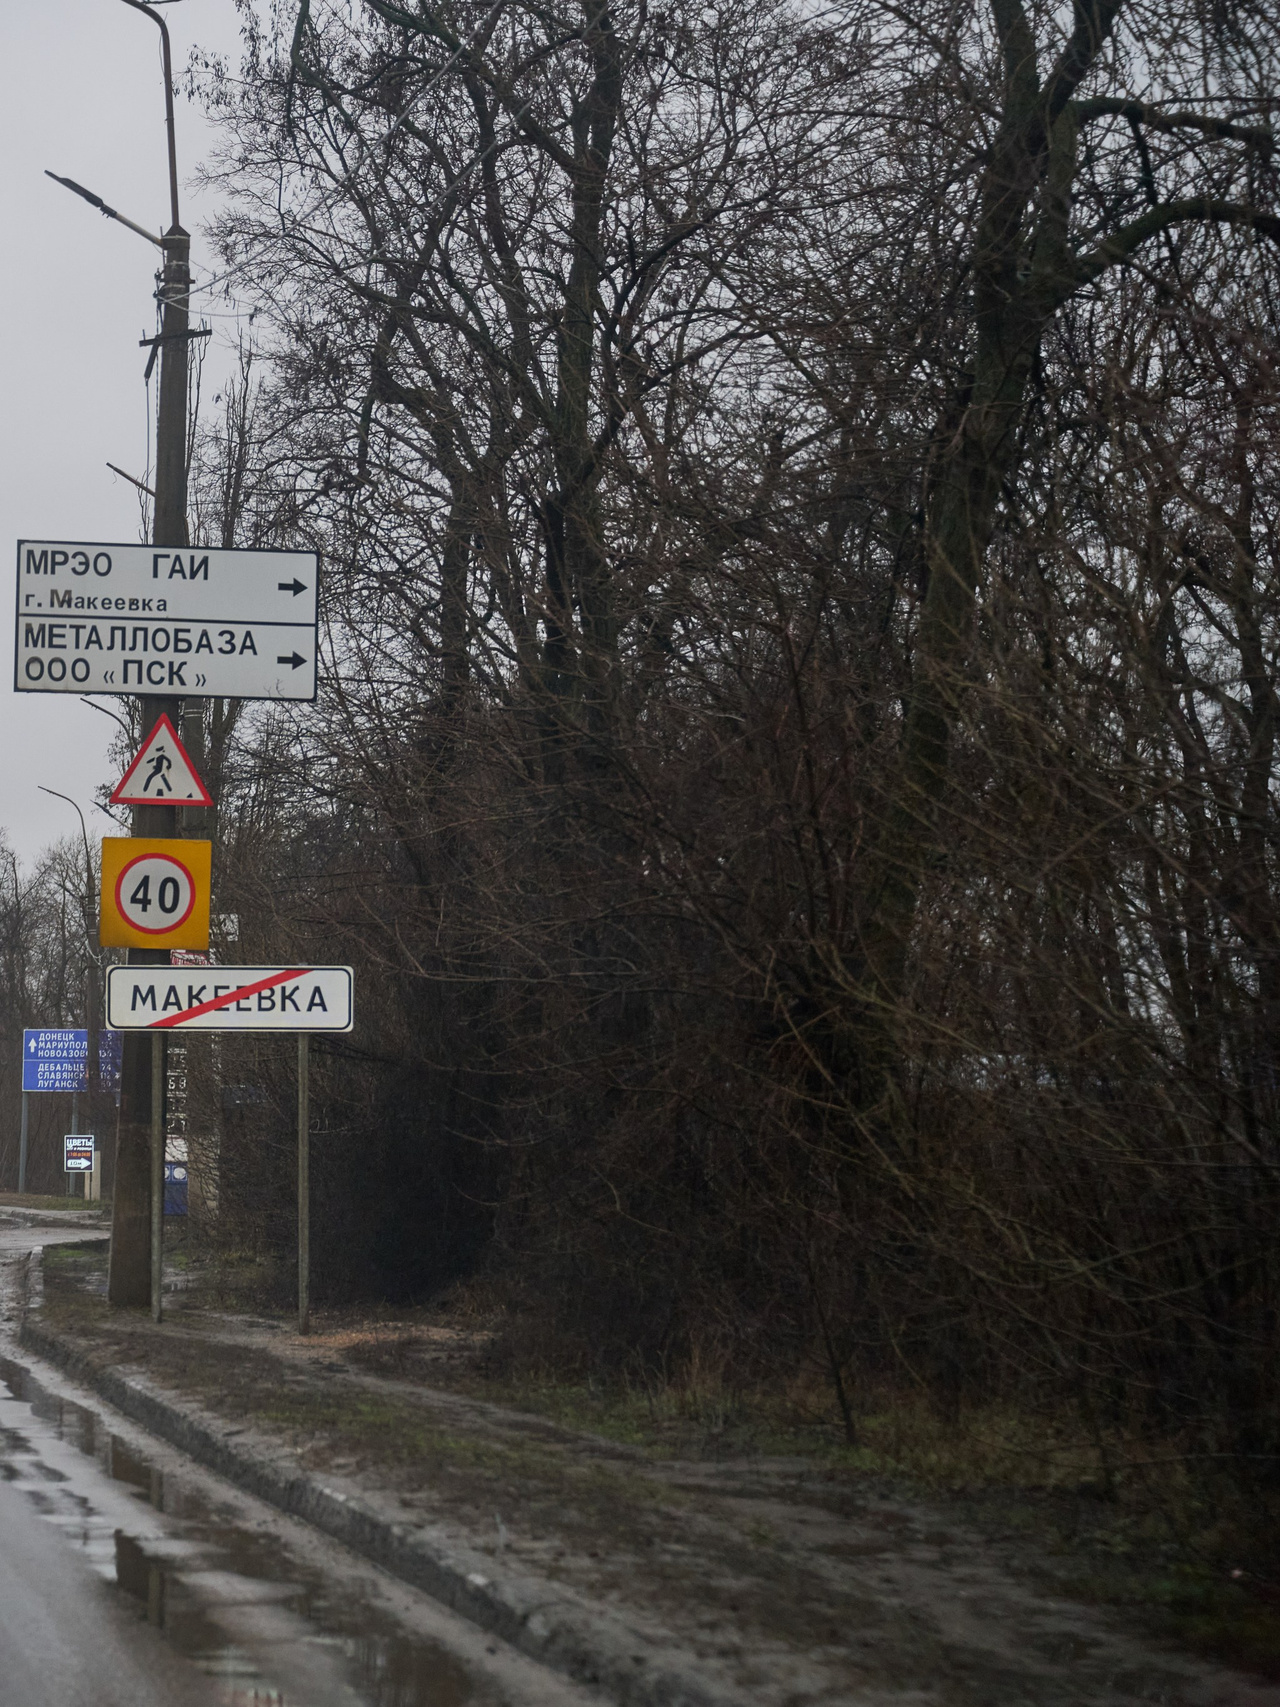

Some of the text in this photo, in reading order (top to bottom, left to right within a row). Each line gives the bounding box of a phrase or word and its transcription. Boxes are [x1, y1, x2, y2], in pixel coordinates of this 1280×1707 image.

[25, 549, 210, 581] МРЭО ГАИ
[24, 589, 168, 612] г. Макеевка
[24, 622, 258, 656] МЕТАЛЛОБАЗА
[25, 656, 91, 683] ООО
[130, 875, 181, 914] 40
[130, 984, 328, 1012] МАКЕЕВКА
[38, 1033, 74, 1042] ДОНЕЦК
[38, 1041, 88, 1049] МАРИУПОЛ
[38, 1050, 88, 1058] НОВОАЗОВ
[37, 1063, 85, 1072] ДЕБАЛЬЦЕ
[37, 1080, 78, 1088] ЛУГАНСК
